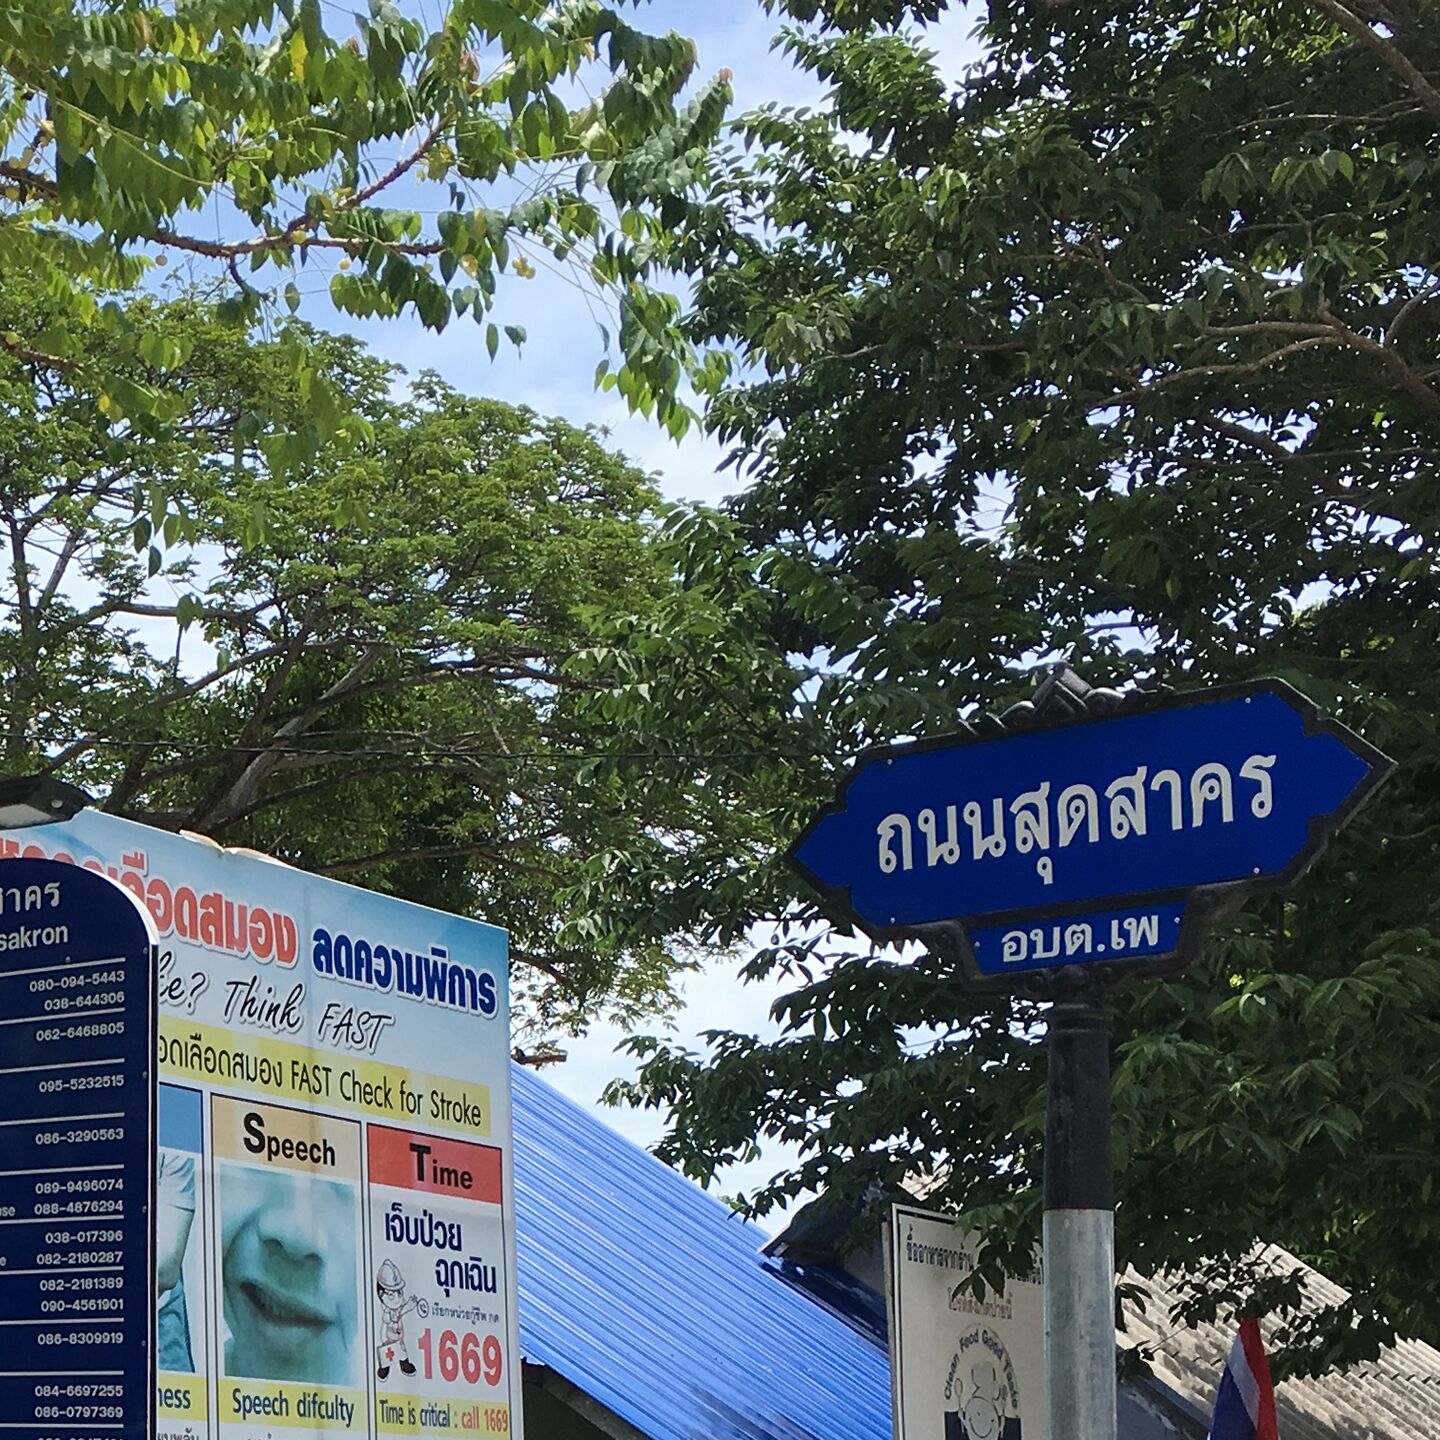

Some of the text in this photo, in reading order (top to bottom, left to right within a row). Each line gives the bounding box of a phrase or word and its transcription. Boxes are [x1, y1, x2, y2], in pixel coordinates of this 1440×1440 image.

[876, 755, 1277, 885] ถนนสุดสาคร
[1002, 914, 1159, 963] อบต.เพ
[29, 971, 125, 992] 080-094-5443
[314, 929, 495, 1014] ลดความพิการ
[44, 992, 125, 1011] 038-644306
[224, 975, 303, 1028] Think
[319, 1003, 392, 1049] FAST
[36, 1022, 125, 1042] 062-6468805
[39, 1075, 124, 1093] 095-5232515
[292, 1060, 481, 1127] FAST Check for Stroke
[35, 1128, 124, 1144] 086-3290563
[244, 1112, 473, 1190] Speech Time
[35, 1179, 124, 1194] 089-9496074
[34, 1200, 123, 1215] 088-4876294
[385, 1202, 461, 1251] เจ็บป่วย
[45, 1231, 123, 1244] 038-017396
[36, 1252, 123, 1266] 082-2180287
[40, 1277, 123, 1291] 082-2181389
[435, 1256, 497, 1298] ฉุกเฉิน
[41, 1299, 124, 1311] 090-4561901
[38, 1333, 123, 1346] 086-8309919
[418, 1328, 502, 1386] 1669
[944, 1353, 960, 1400] Clean
[960, 1329, 979, 1353] Food
[982, 1330, 1004, 1360] Good
[35, 1385, 123, 1397] 084-6697255
[35, 1406, 123, 1418] 086-0797369
[232, 1388, 289, 1420] Speech
[380, 1399, 508, 1432] Time is critical call 1669
